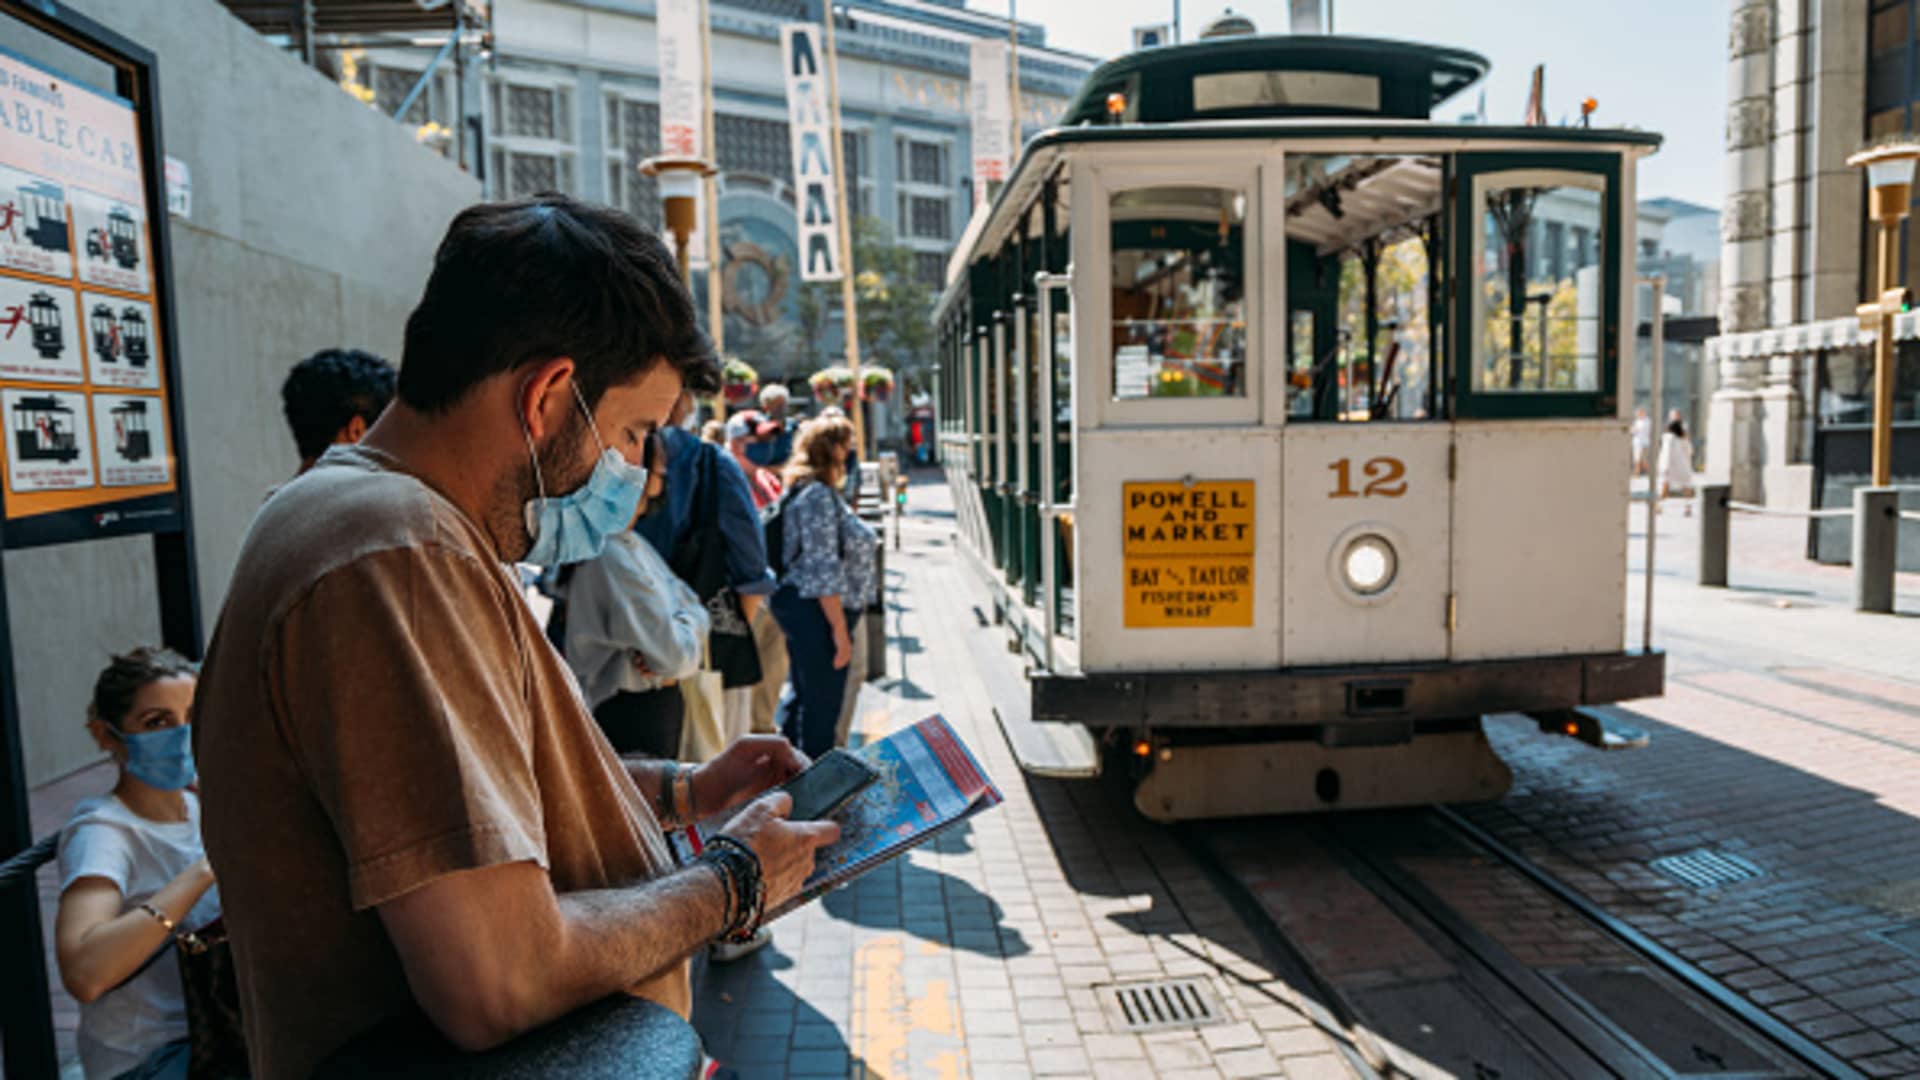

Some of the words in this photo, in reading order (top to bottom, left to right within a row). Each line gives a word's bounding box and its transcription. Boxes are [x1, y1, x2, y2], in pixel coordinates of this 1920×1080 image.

[1327, 456, 1409, 499] 12
[1131, 490, 1248, 509] POWELL
[1162, 510, 1217, 522] AND
[1128, 523, 1248, 542] MARKET
[1131, 567, 1160, 586] BAY
[1189, 565, 1249, 585] TAYLOR
